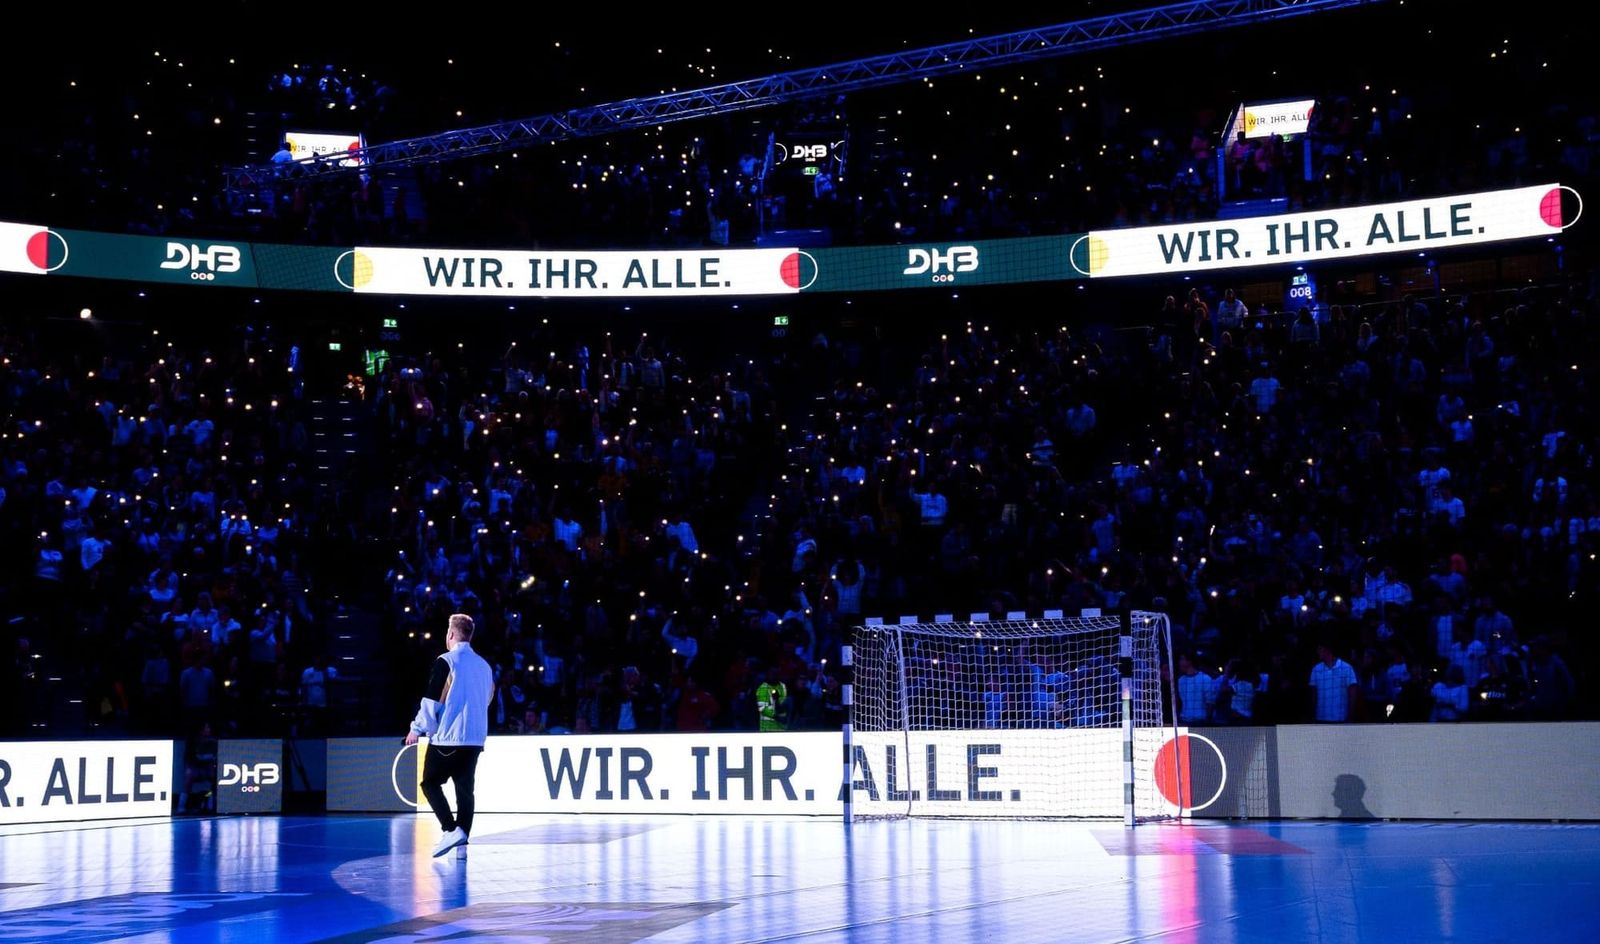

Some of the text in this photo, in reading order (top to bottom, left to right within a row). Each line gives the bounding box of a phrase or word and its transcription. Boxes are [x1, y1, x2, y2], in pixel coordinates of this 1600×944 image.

[791, 144, 827, 159] DHB
[1157, 202, 1485, 265] WIR. IHR. ALLE.
[160, 241, 241, 272] DHB
[903, 245, 979, 275] DHB
[423, 257, 731, 289] WIR. IHR. ALLE.
[1290, 286, 1312, 298] 008
[41, 756, 167, 806] ALLE.
[218, 762, 279, 785] DHB
[539, 744, 1021, 801] WIR. IHR. ALLE.
